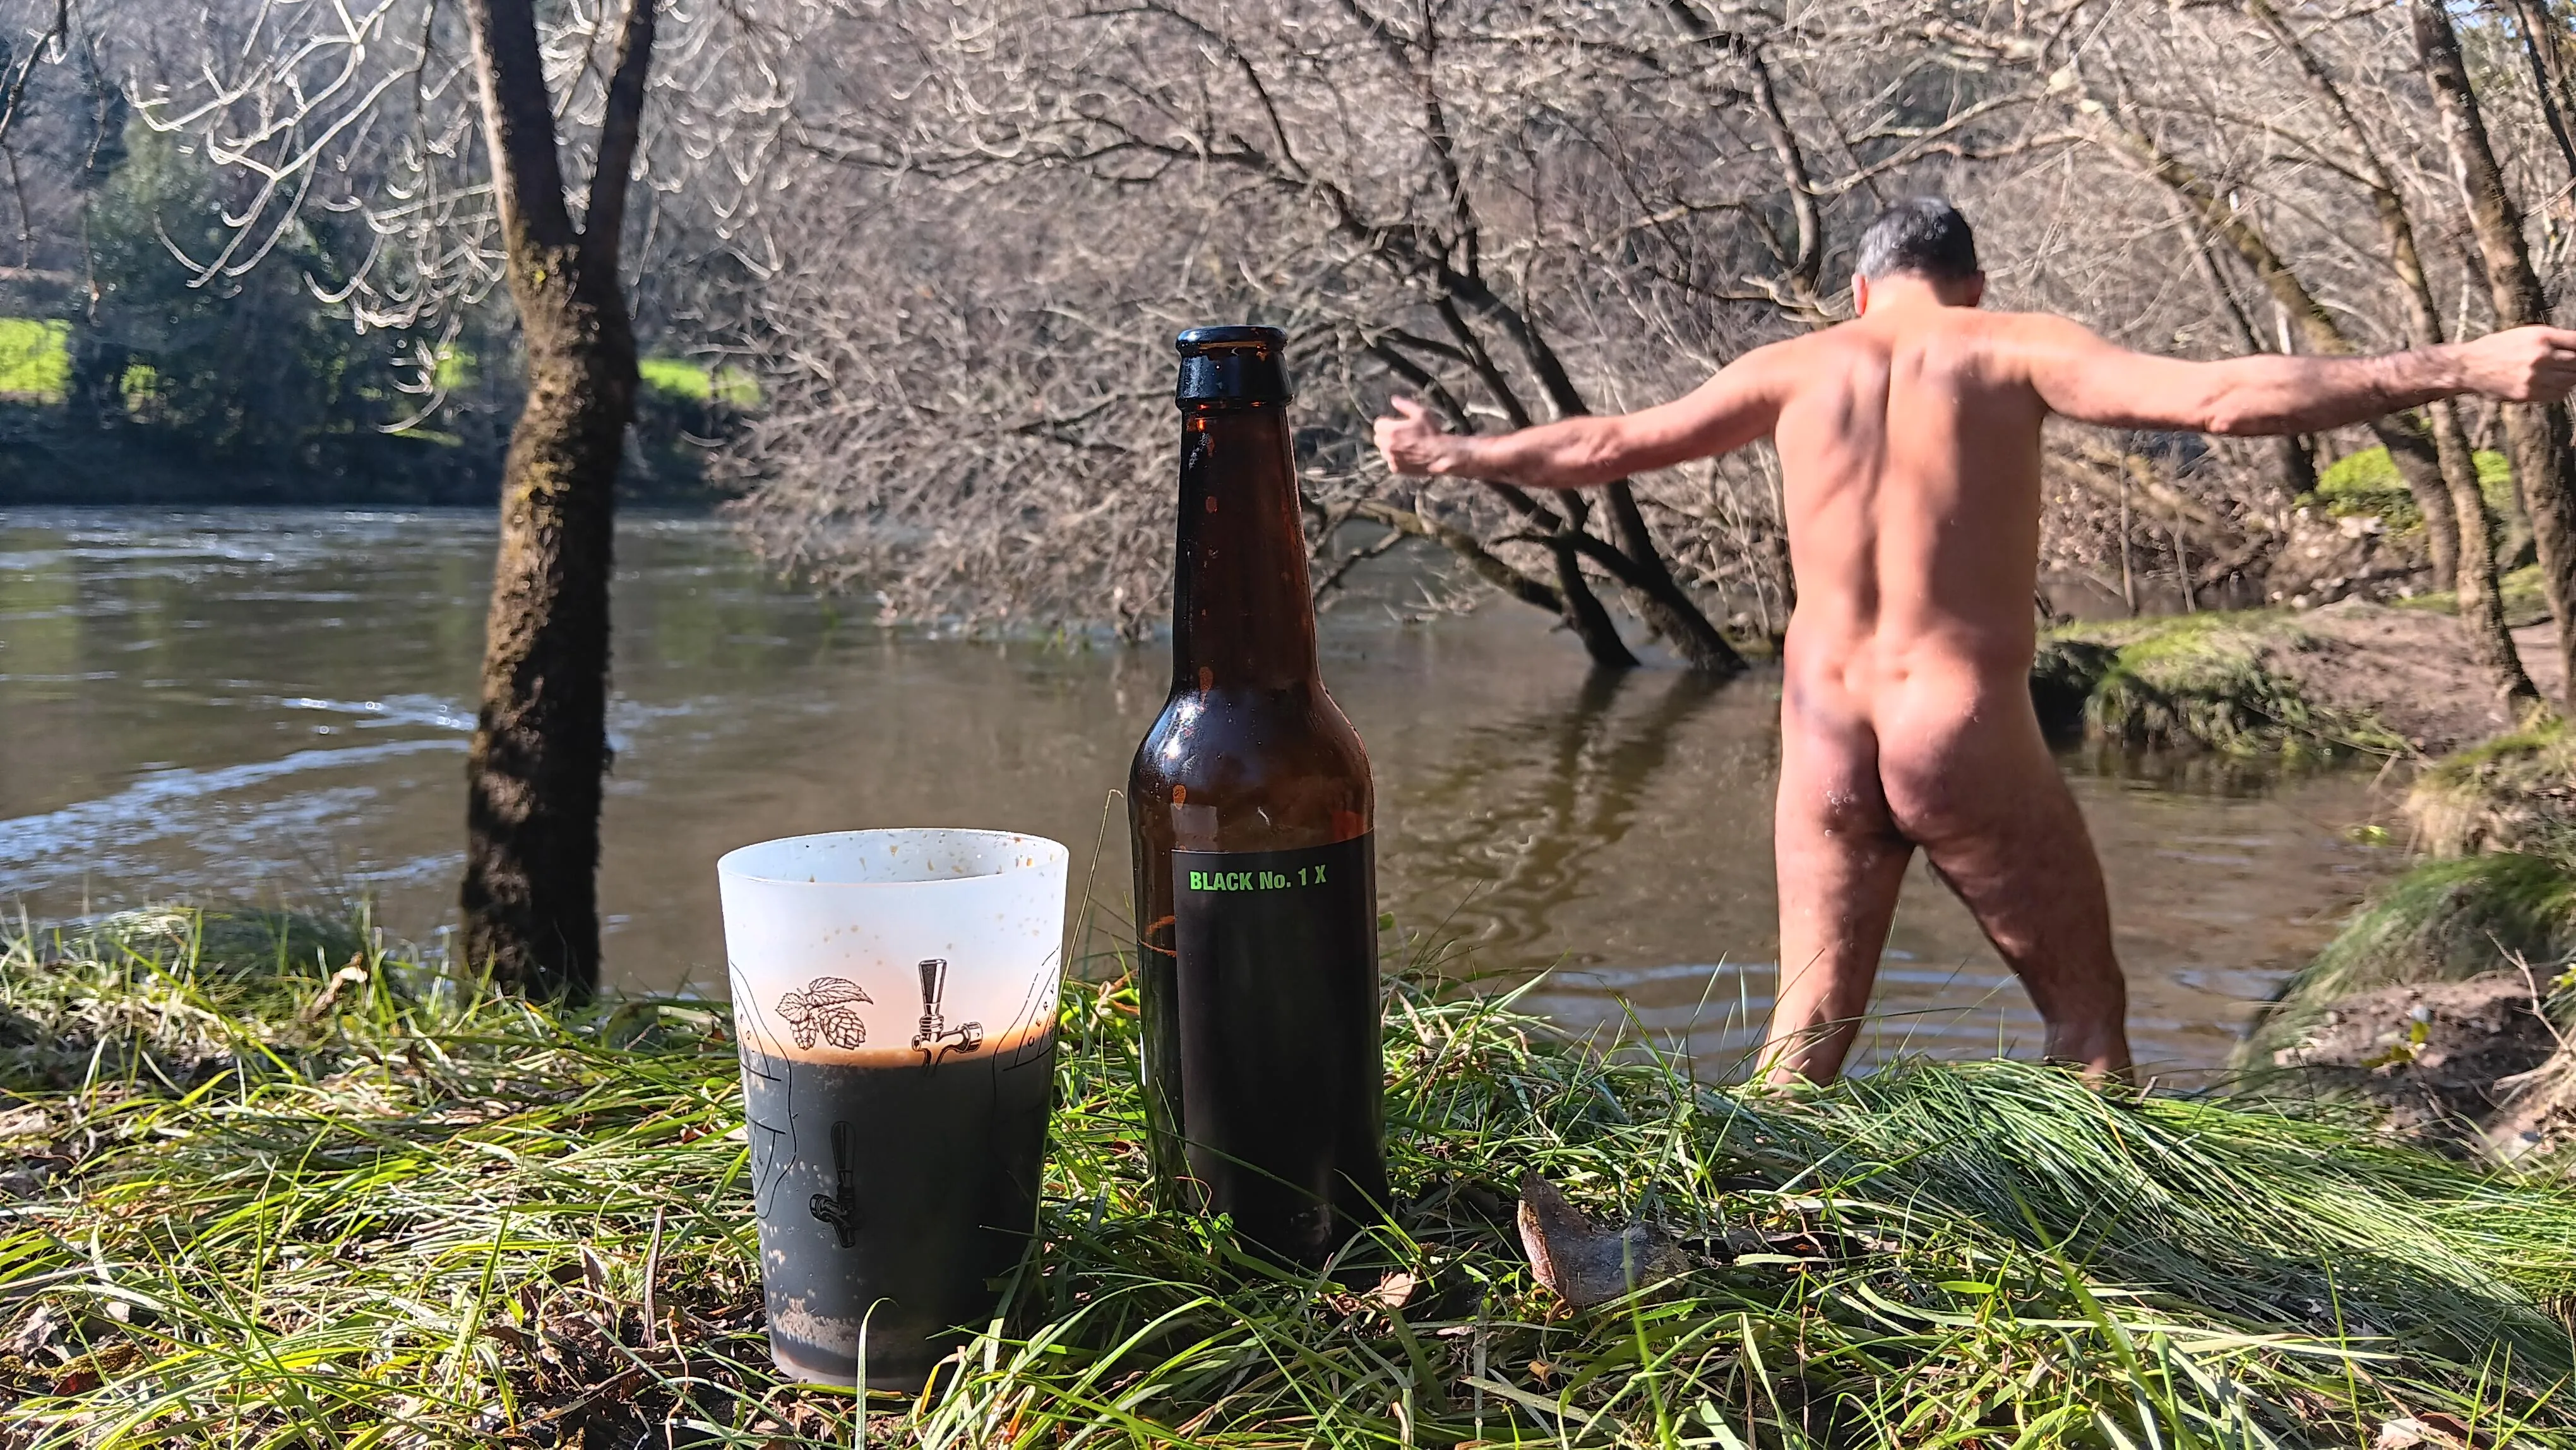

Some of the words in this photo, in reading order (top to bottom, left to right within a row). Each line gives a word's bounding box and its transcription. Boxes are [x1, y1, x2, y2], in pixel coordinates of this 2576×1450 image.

[1190, 871, 1253, 891] BLACK
[1259, 871, 1291, 890] No.
[1297, 867, 1307, 886] 1
[1315, 864, 1327, 884] X
